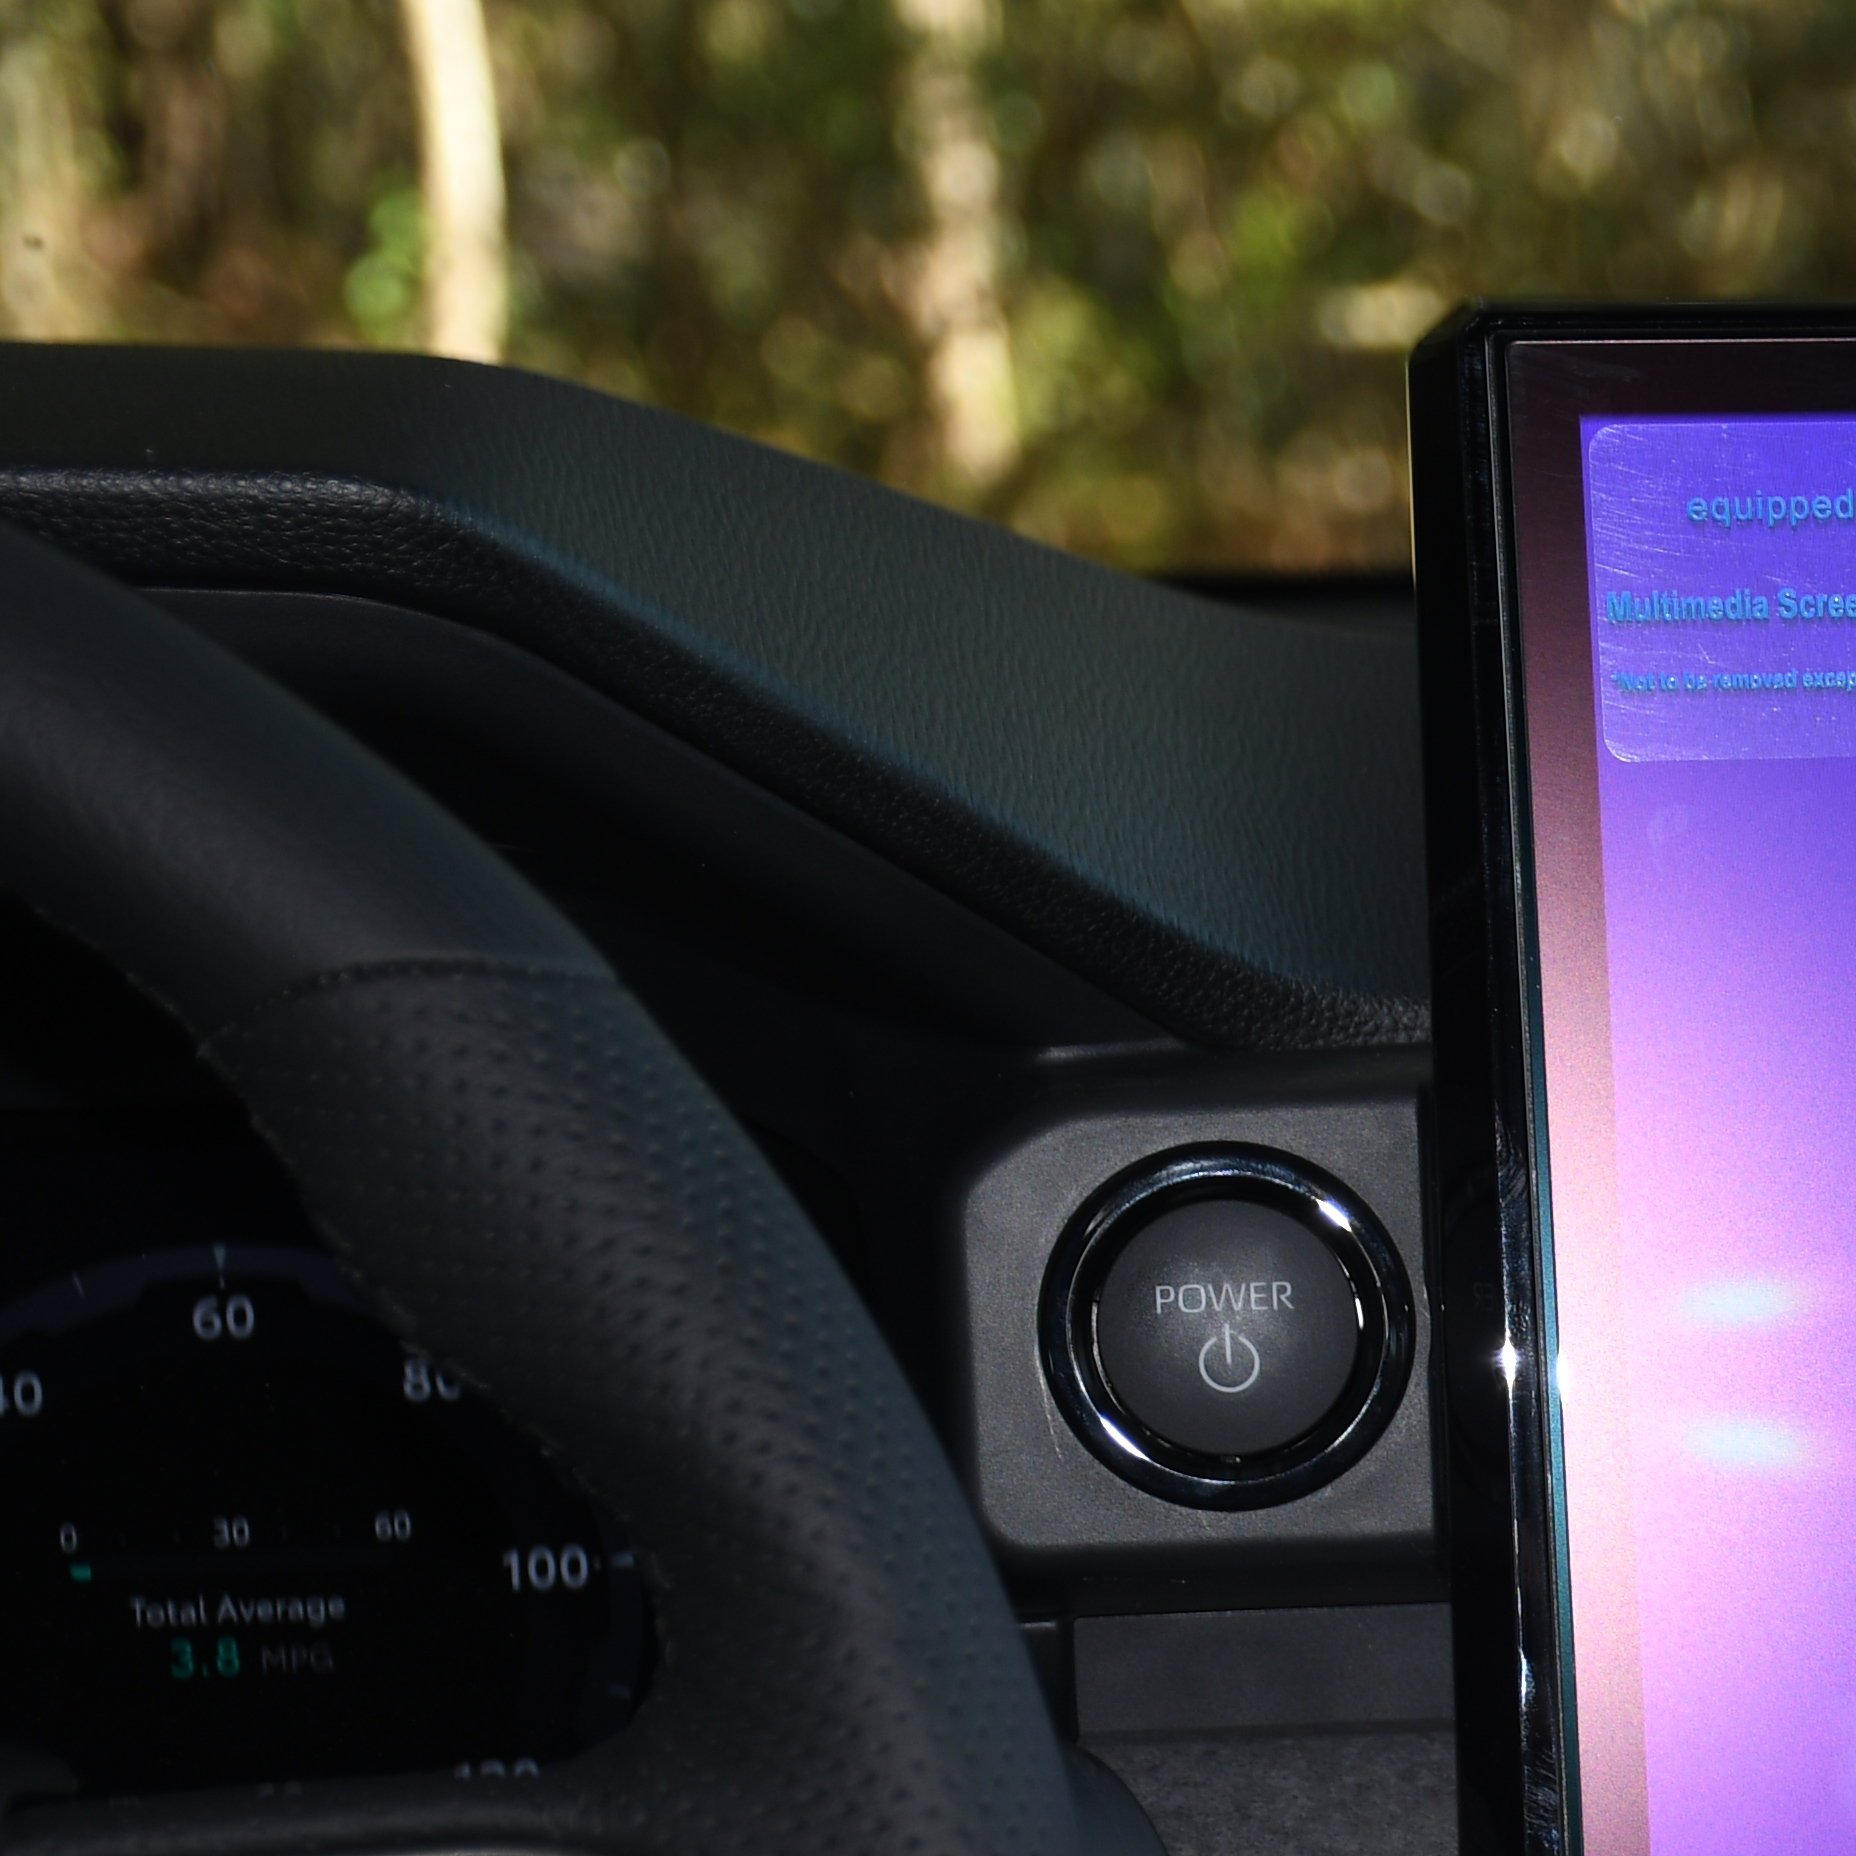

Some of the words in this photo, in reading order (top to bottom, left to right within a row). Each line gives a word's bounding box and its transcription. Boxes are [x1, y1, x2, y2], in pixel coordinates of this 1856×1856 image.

[1686, 490, 1855, 528] equipped
[1607, 588, 1770, 623] Multimedia
[1660, 671, 1680, 690] to
[1683, 670, 1707, 690] be
[1713, 669, 1798, 689] removed
[1154, 1280, 1295, 1315] POWER
[191, 1294, 256, 1341] 60
[58, 1522, 78, 1554] 0
[212, 1514, 251, 1549] 30
[374, 1508, 412, 1543] 60
[502, 1544, 589, 1592] 100
[129, 1594, 208, 1629] Total
[216, 1595, 347, 1630] Average
[170, 1636, 241, 1680] 3.8
[260, 1642, 336, 1676] MPG
